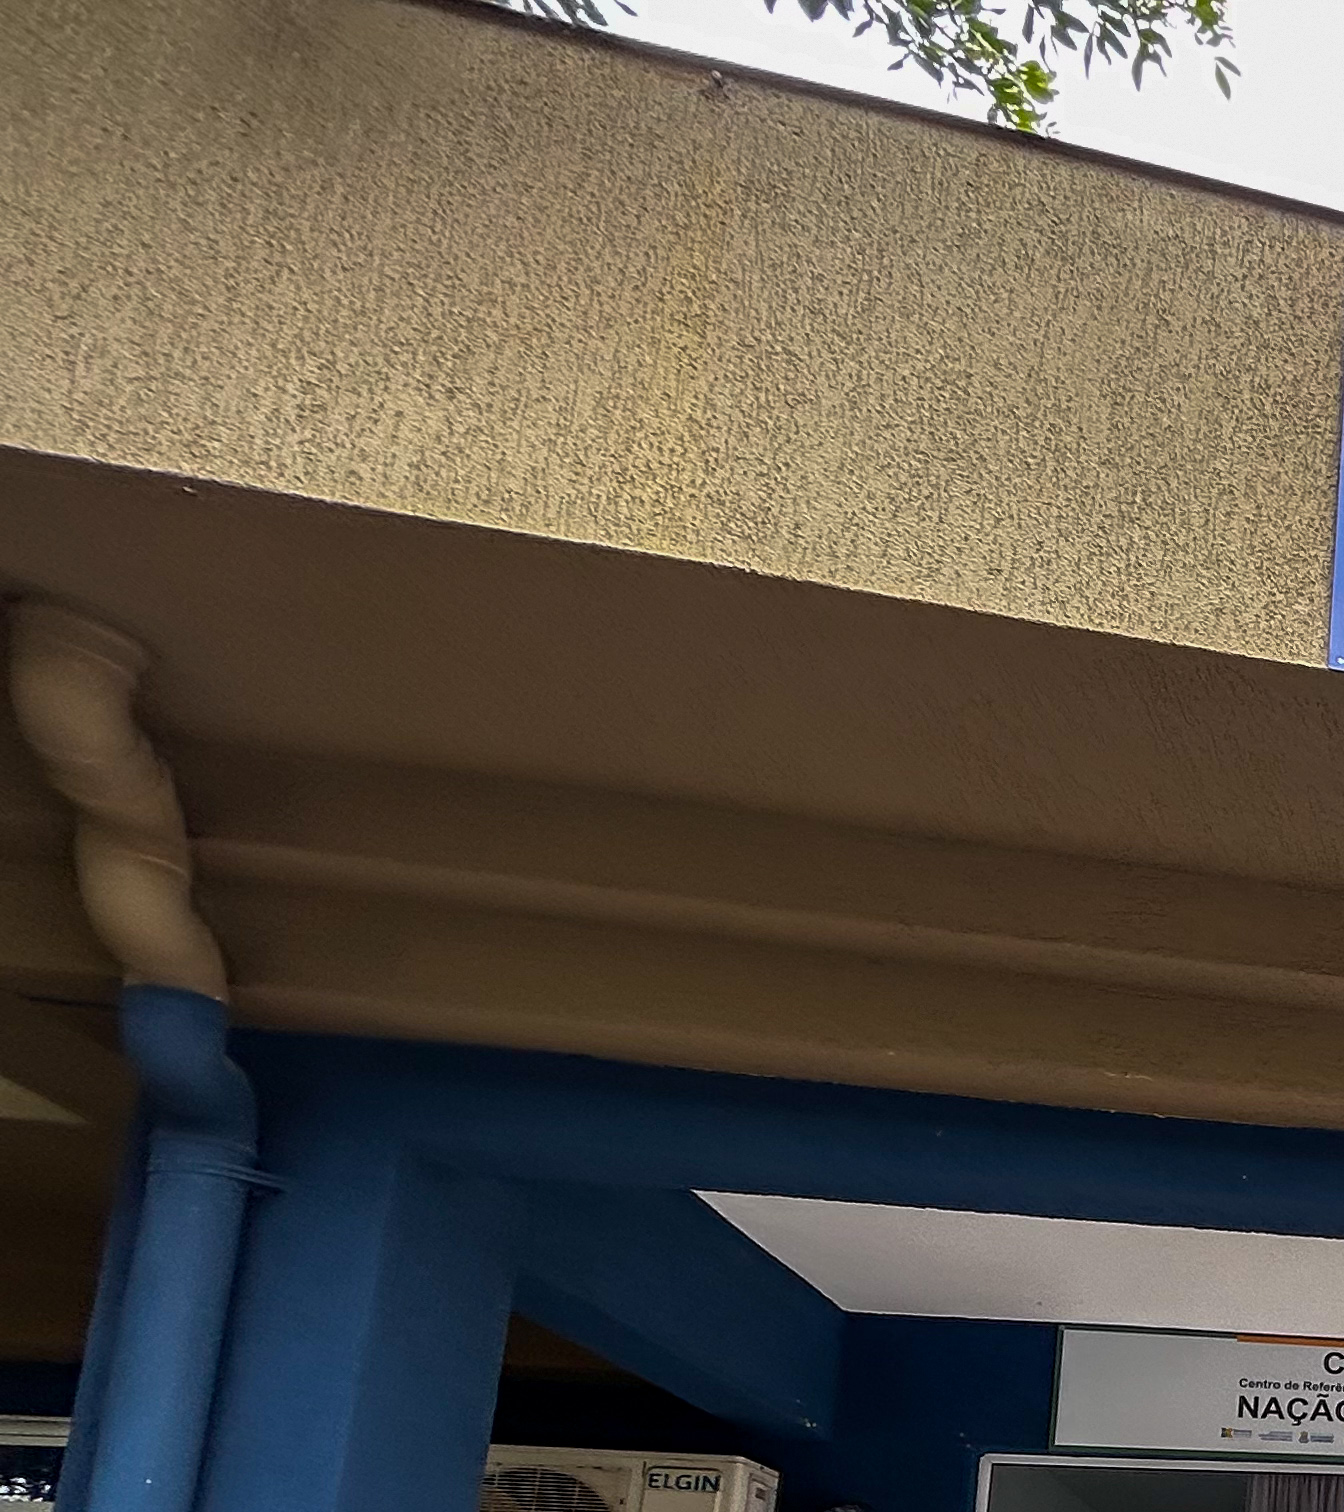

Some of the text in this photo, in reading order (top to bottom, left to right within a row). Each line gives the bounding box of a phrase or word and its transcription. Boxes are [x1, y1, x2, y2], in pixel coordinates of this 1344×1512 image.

[1238, 1378, 1282, 1391] Centro
[1284, 1379, 1300, 1391] de
[647, 1473, 722, 1492] ELGIN
